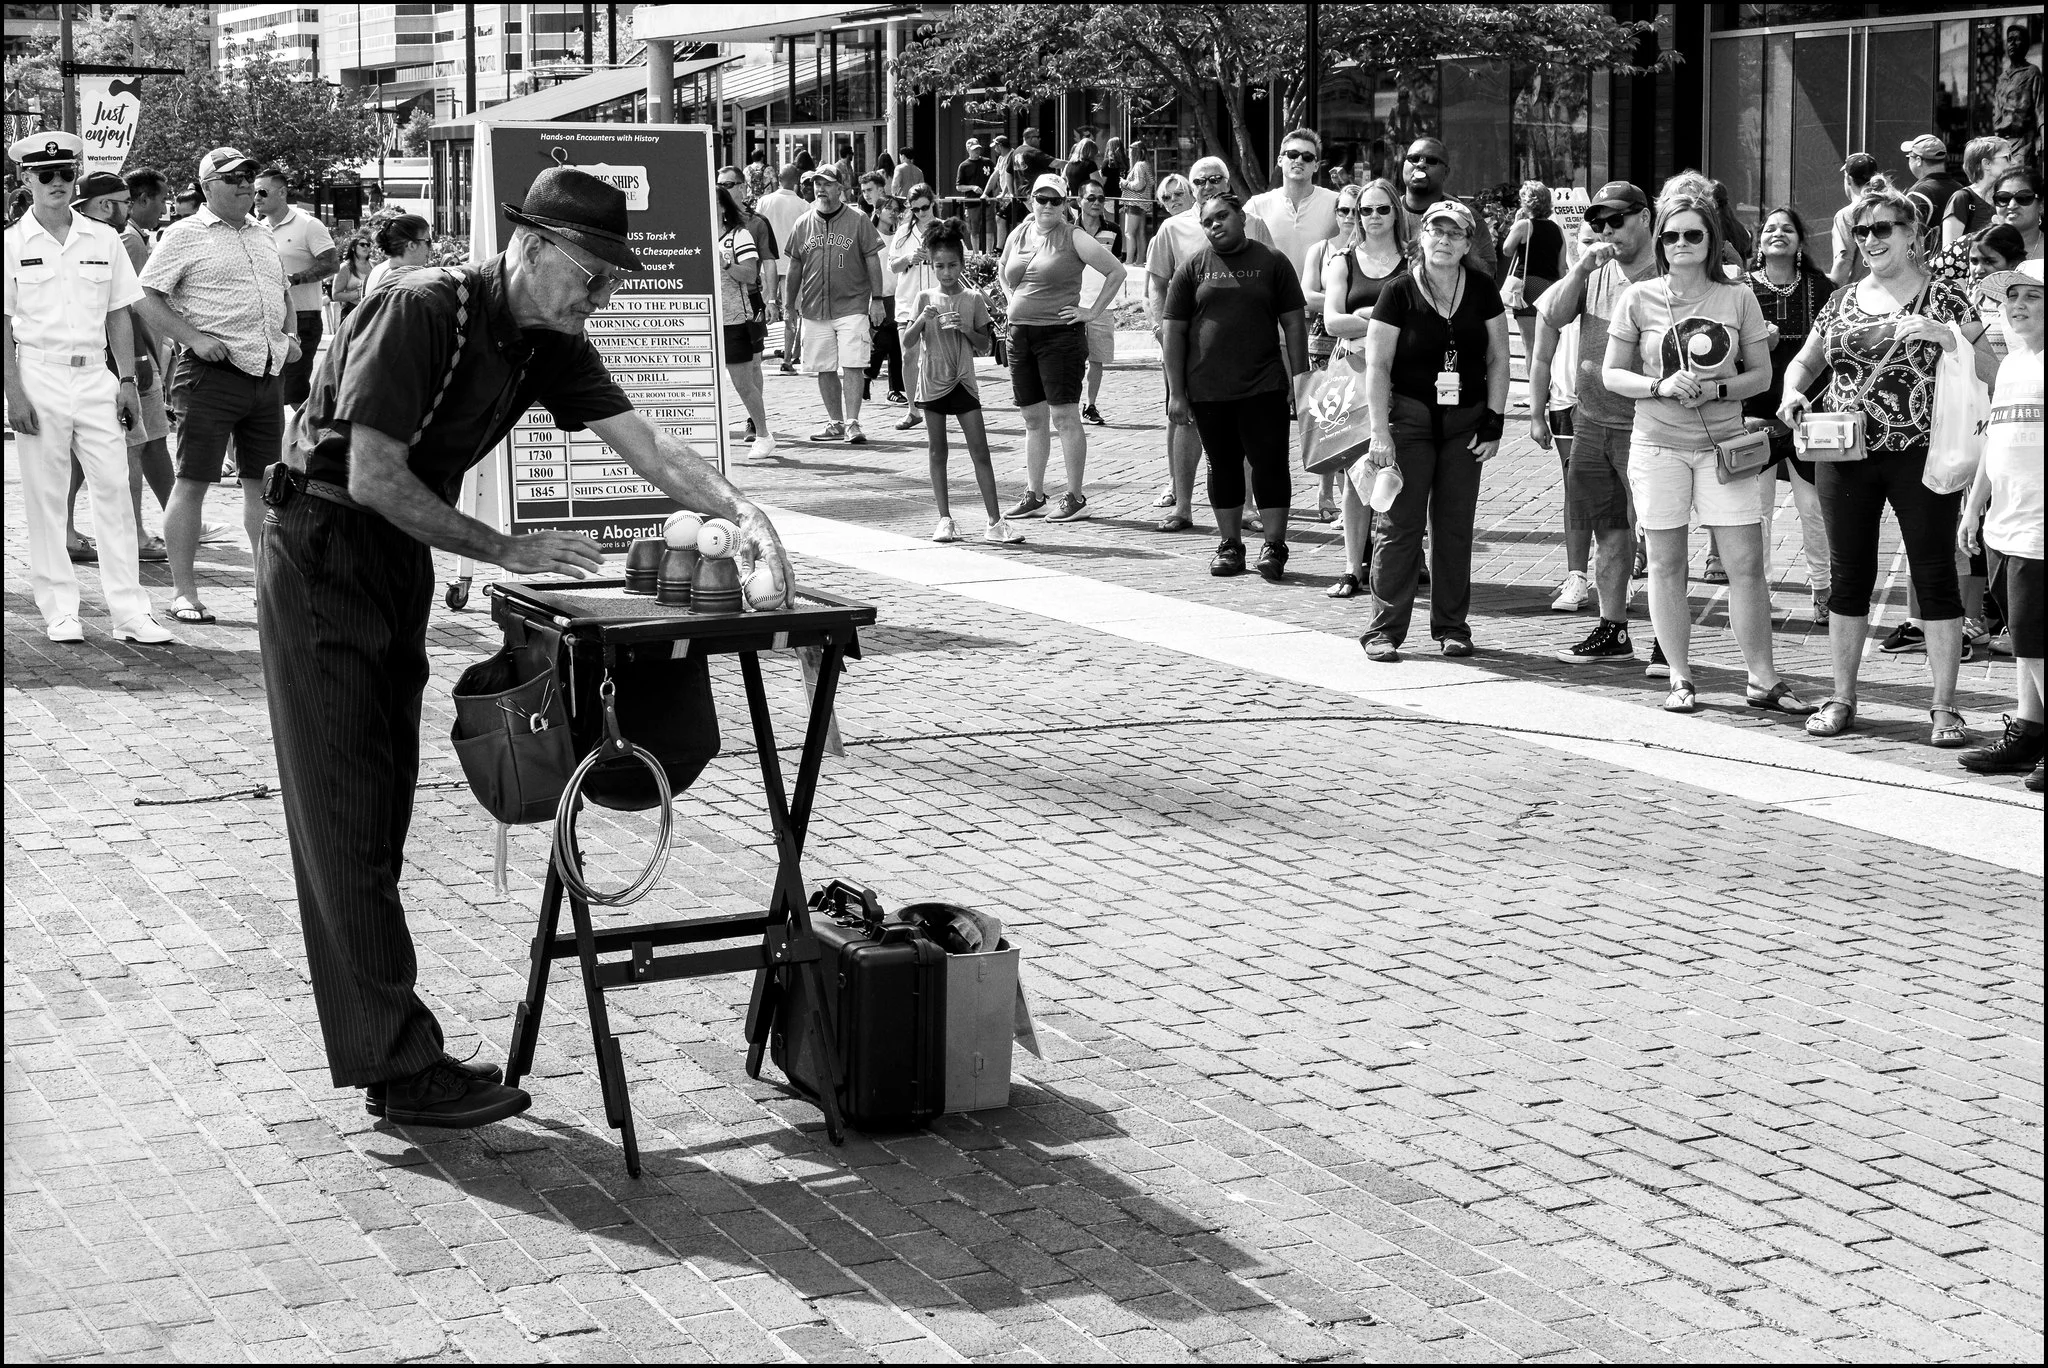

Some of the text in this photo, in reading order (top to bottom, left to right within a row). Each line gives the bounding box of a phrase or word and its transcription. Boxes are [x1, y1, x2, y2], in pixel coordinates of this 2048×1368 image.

[91, 101, 129, 125] Just
[85, 123, 133, 149] enjoy!
[540, 133, 660, 143] Hands-on Encounters with History
[612, 175, 640, 189] SHIPS
[627, 232, 668, 240] USS Torsk
[803, 233, 853, 254] ASTROS
[643, 247, 693, 258] Chesapeake
[1197, 269, 1261, 282] BREAKOUT
[620, 279, 684, 290] NTATIONS
[605, 301, 706, 311] PEN TO THE PUBLIC
[589, 318, 685, 329] MORNING COLORS
[651, 337, 690, 346] FIRING!
[600, 354, 701, 364] DER MONKEY TOUR
[611, 374, 635, 383] GUN
[637, 373, 669, 382] DRILL
[655, 408, 694, 417] FIRING!
[527, 413, 552, 424] 1600
[528, 431, 552, 443] 1700
[528, 449, 552, 461] 1730
[529, 467, 553, 478] 1800
[602, 467, 630, 477] LAST
[530, 484, 655, 498] 1845 SHIPS CLOSE TO
[603, 523, 663, 540] Aboard!
